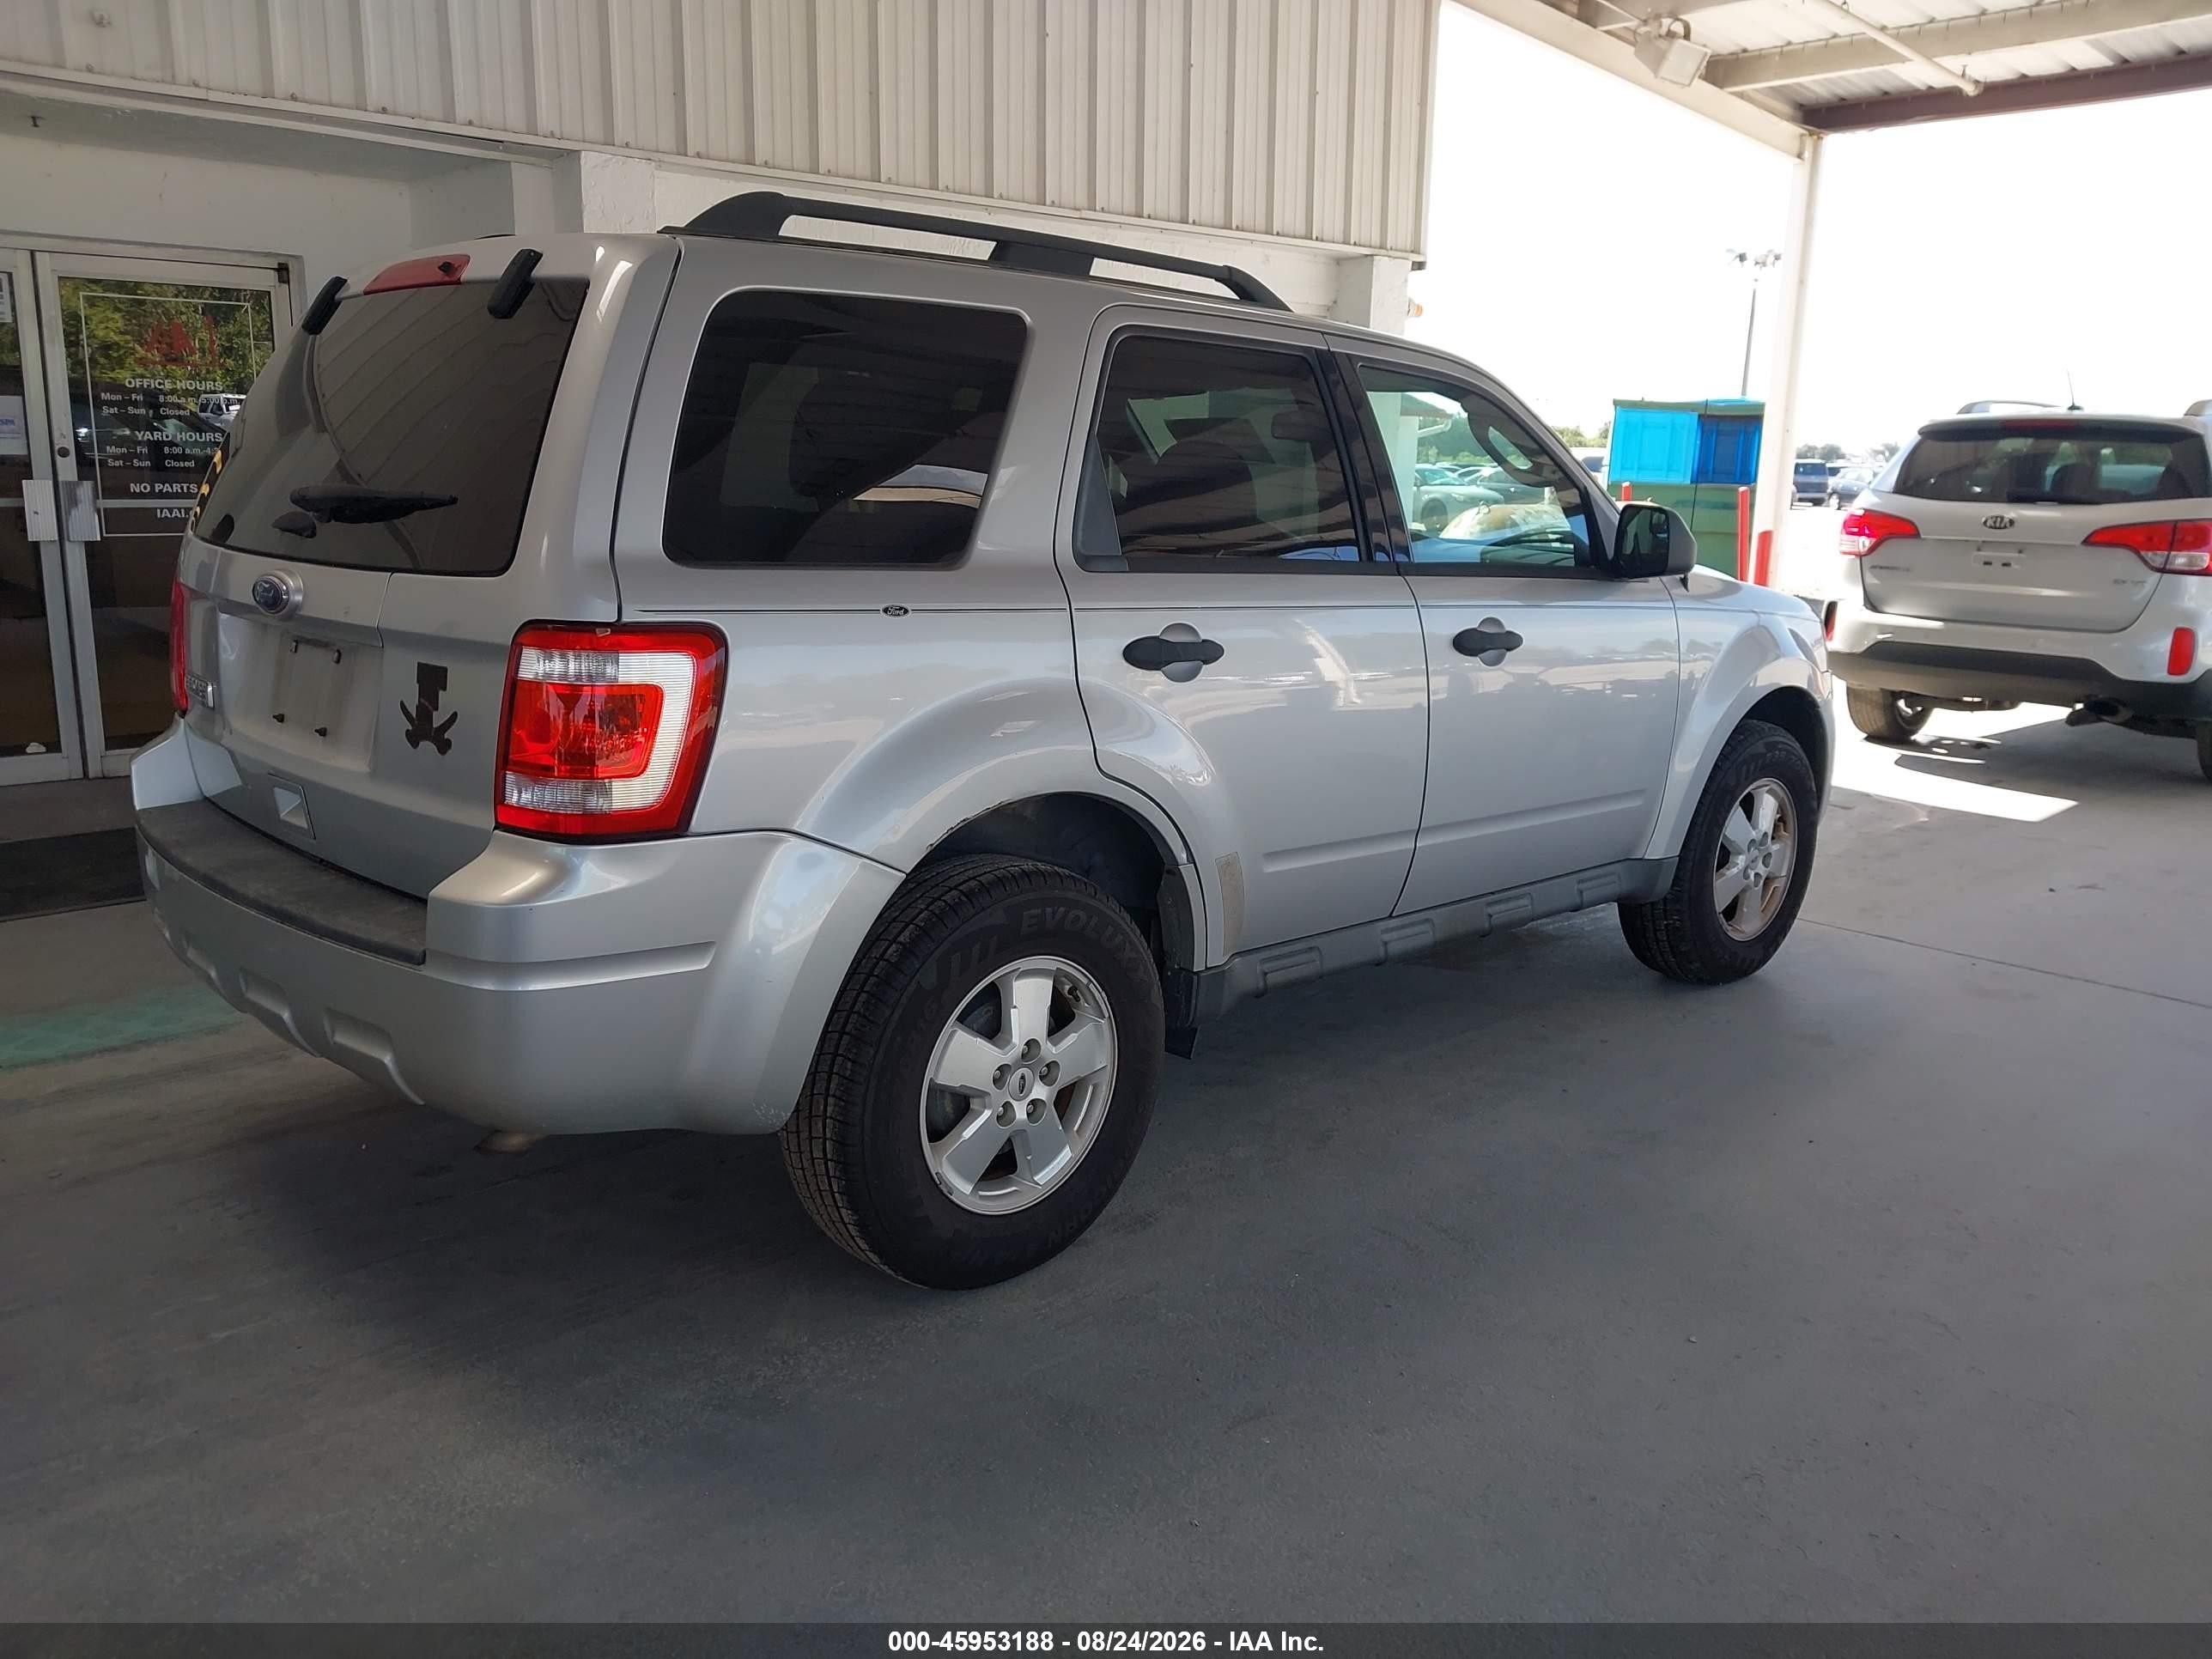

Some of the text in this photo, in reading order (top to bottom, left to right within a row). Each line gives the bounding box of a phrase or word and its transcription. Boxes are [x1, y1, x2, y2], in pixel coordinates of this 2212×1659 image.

[125, 378, 223, 391] OFFICE HOURS
[100, 392, 122, 401] Mon
[131, 393, 143, 402] Fri
[102, 406, 118, 415] Sat
[160, 407, 191, 416] Closed
[135, 431, 222, 442] YARD HOURS
[106, 446, 127, 454] Mon
[137, 446, 148, 454] Fri
[130, 483, 198, 494] NO PARTS
[1986, 517, 2010, 528] KIA
